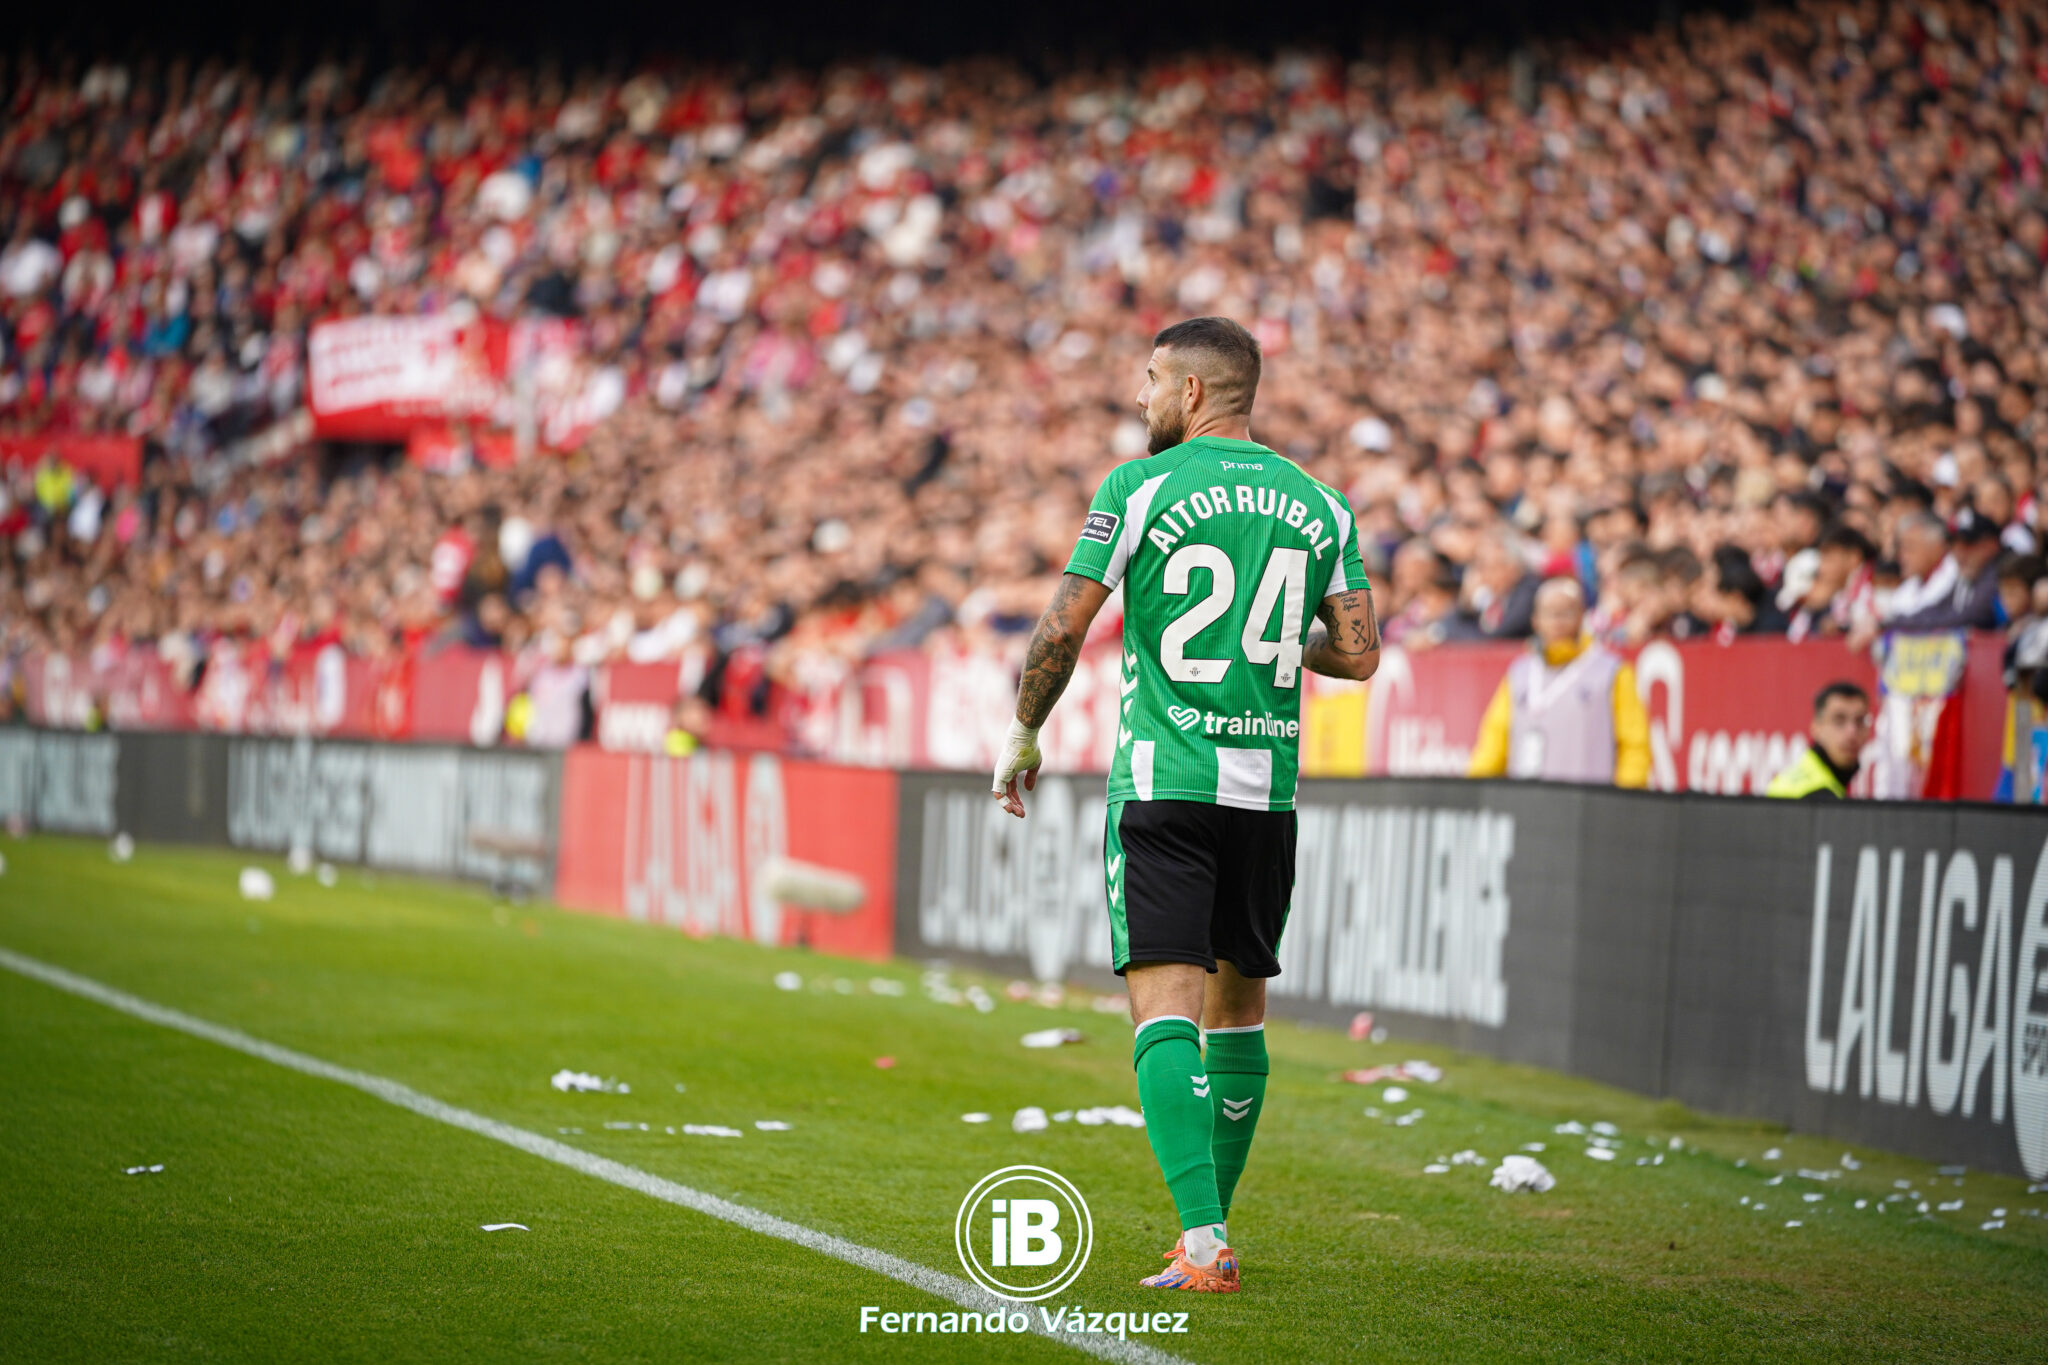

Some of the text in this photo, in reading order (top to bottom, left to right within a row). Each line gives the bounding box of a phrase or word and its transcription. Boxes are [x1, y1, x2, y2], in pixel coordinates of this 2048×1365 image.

[1219, 460, 1264, 472] prima
[1084, 516, 1112, 529] VEL
[1147, 484, 1334, 561] AITOR RUIBAL
[1160, 542, 1310, 690] 24
[1203, 709, 1299, 738] trainline
[1804, 842, 2015, 1124] LALIGA
